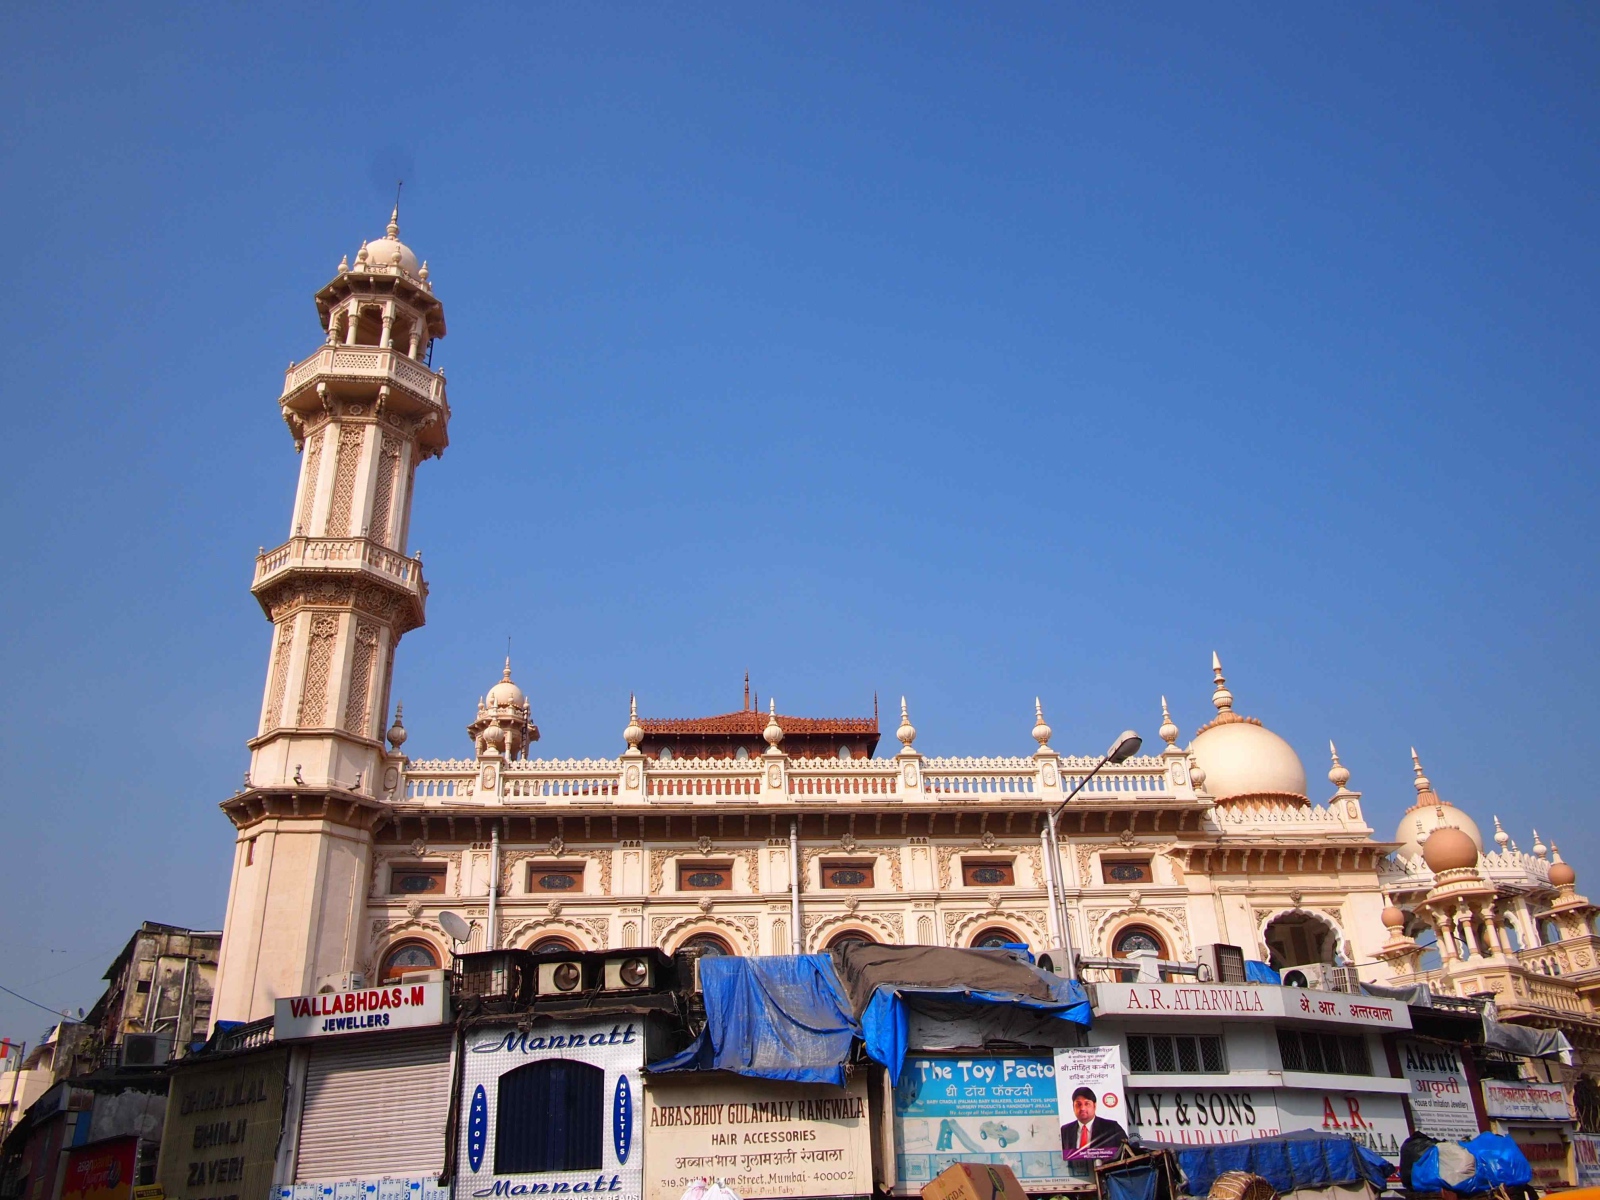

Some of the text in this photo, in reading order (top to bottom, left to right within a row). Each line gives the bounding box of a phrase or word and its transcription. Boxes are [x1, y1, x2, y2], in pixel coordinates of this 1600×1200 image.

[1174, 989, 1264, 1011] ATTARWALA
[322, 1013, 390, 1032] JEWELLERS
[472, 1023, 636, 1055] Mannatt
[915, 1061, 952, 1082] The
[957, 1060, 996, 1083] Toy
[1405, 1044, 1460, 1073] Akruti
[1415, 1077, 1460, 1098] आकृती
[619, 1082, 627, 1156] NOVELTIES
[650, 1097, 865, 1127] ABBASBHOY GULAMALY RANGWALA
[1174, 1093, 1191, 1126] &
[1194, 1093, 1256, 1126] SONS
[1322, 1096, 1373, 1128] A.R.
[473, 1092, 482, 1164] EXPORT
[711, 1130, 816, 1146] HAIR ACCESSORIES
[675, 1148, 844, 1172] अब्बासभाय गुलामअली रंगवाला
[472, 1175, 623, 1199] Mannatt
